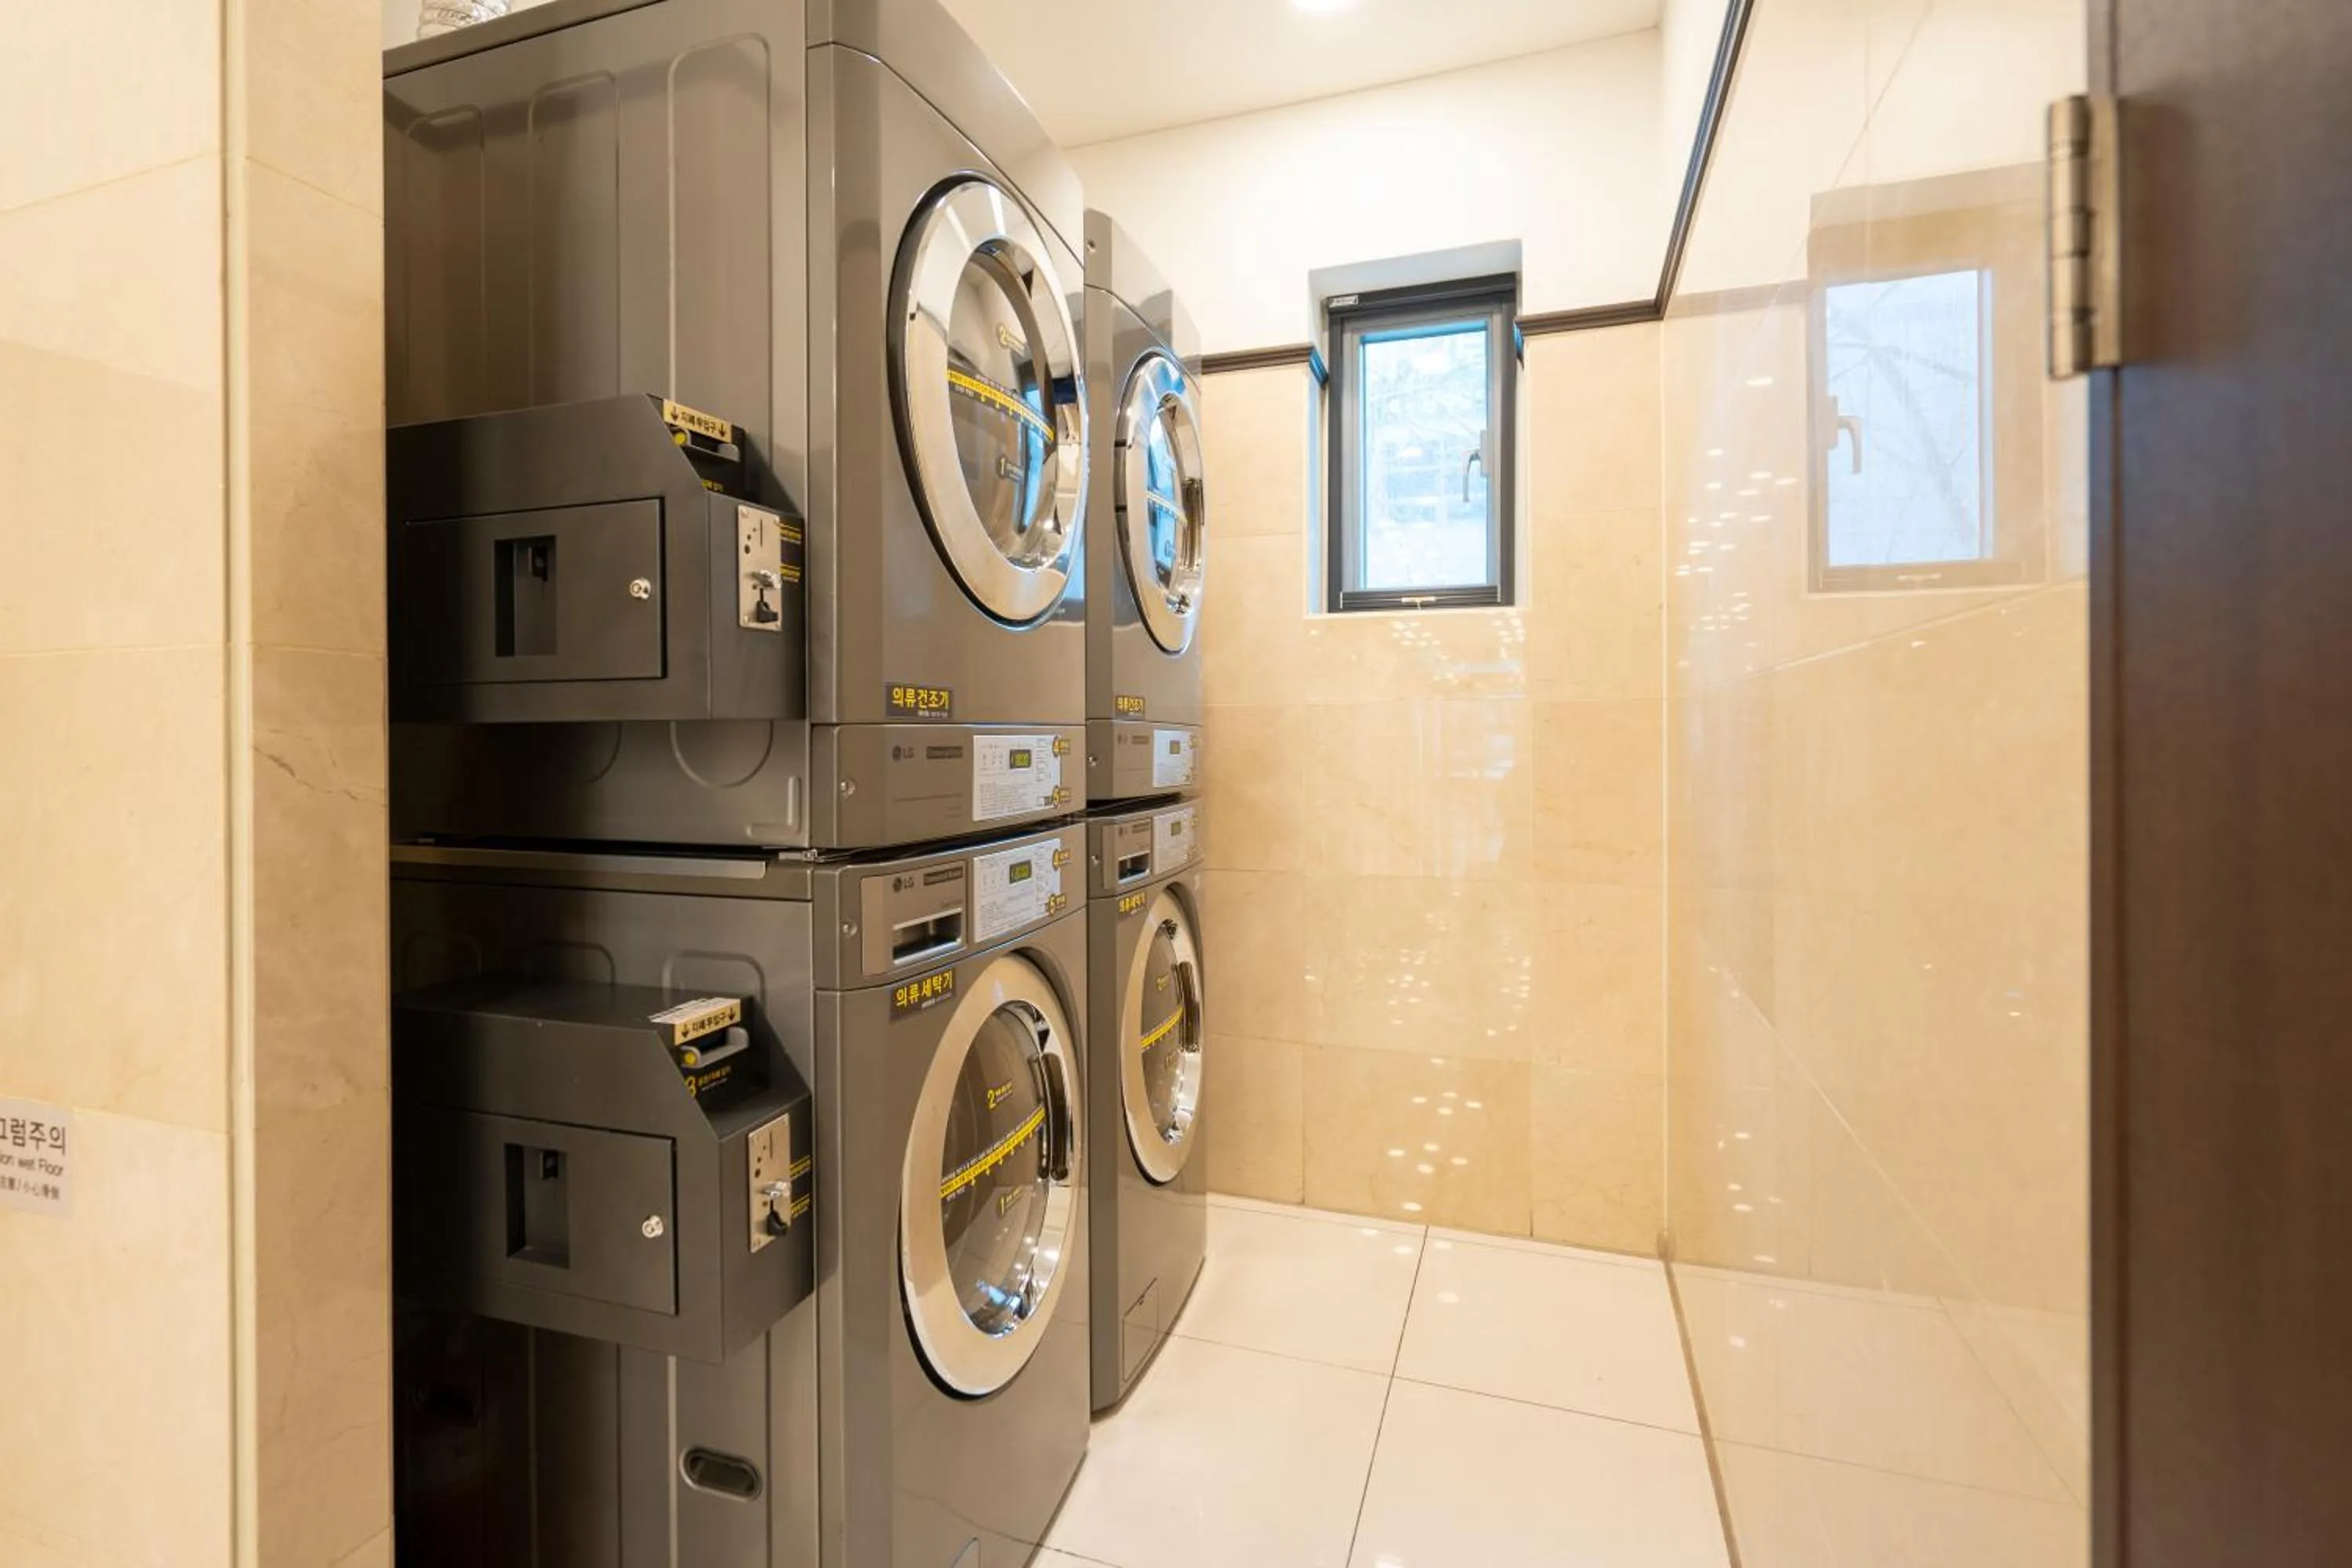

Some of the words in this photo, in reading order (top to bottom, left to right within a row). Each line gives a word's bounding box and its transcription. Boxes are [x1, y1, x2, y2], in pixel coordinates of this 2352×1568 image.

[891, 688, 949, 710] 의류건조기
[896, 970, 953, 1007] 의류세탁기
[987, 1090, 996, 1109] 2
[38, 1158, 64, 1177] Floor
